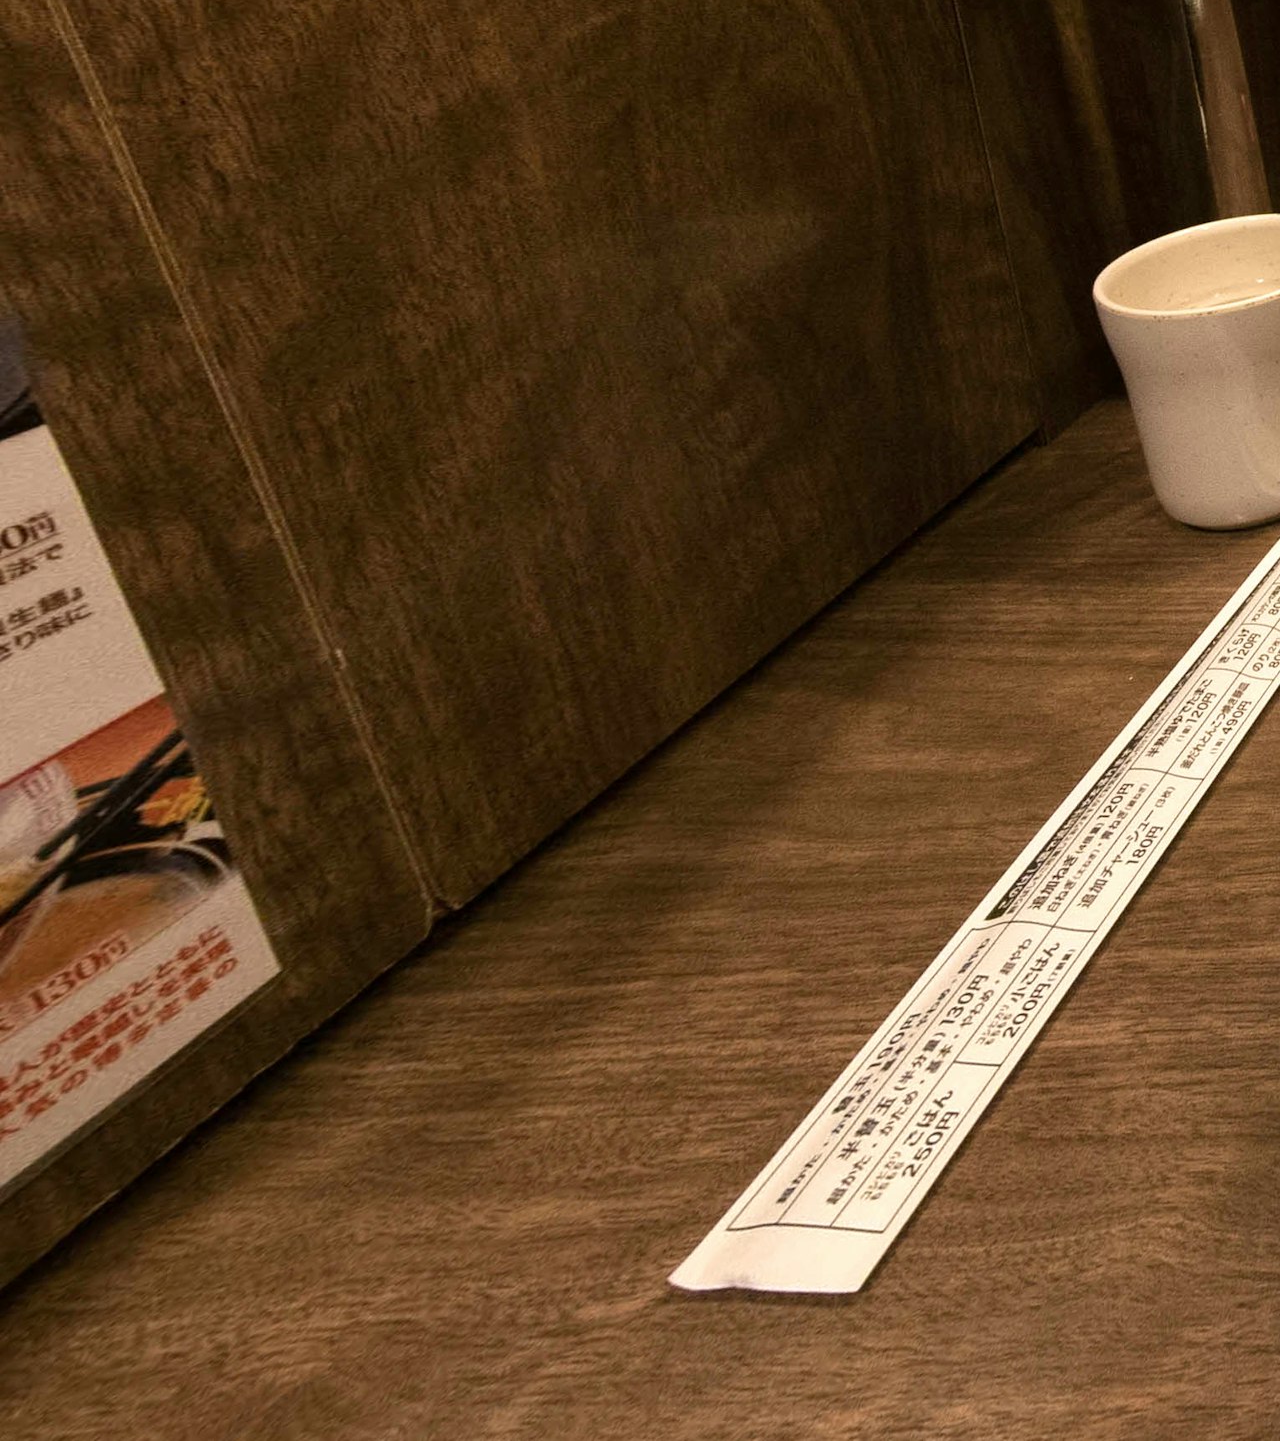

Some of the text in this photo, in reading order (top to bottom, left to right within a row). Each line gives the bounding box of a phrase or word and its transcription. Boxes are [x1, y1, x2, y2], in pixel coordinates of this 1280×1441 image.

[1231, 631, 1262, 662] 120円
[1124, 824, 1165, 867] 180円
[940, 972, 991, 1028] 130円
[1002, 981, 1053, 1040] 200円
[901, 1109, 961, 1180] 250円
[902, 1088, 955, 1148] ごはん
